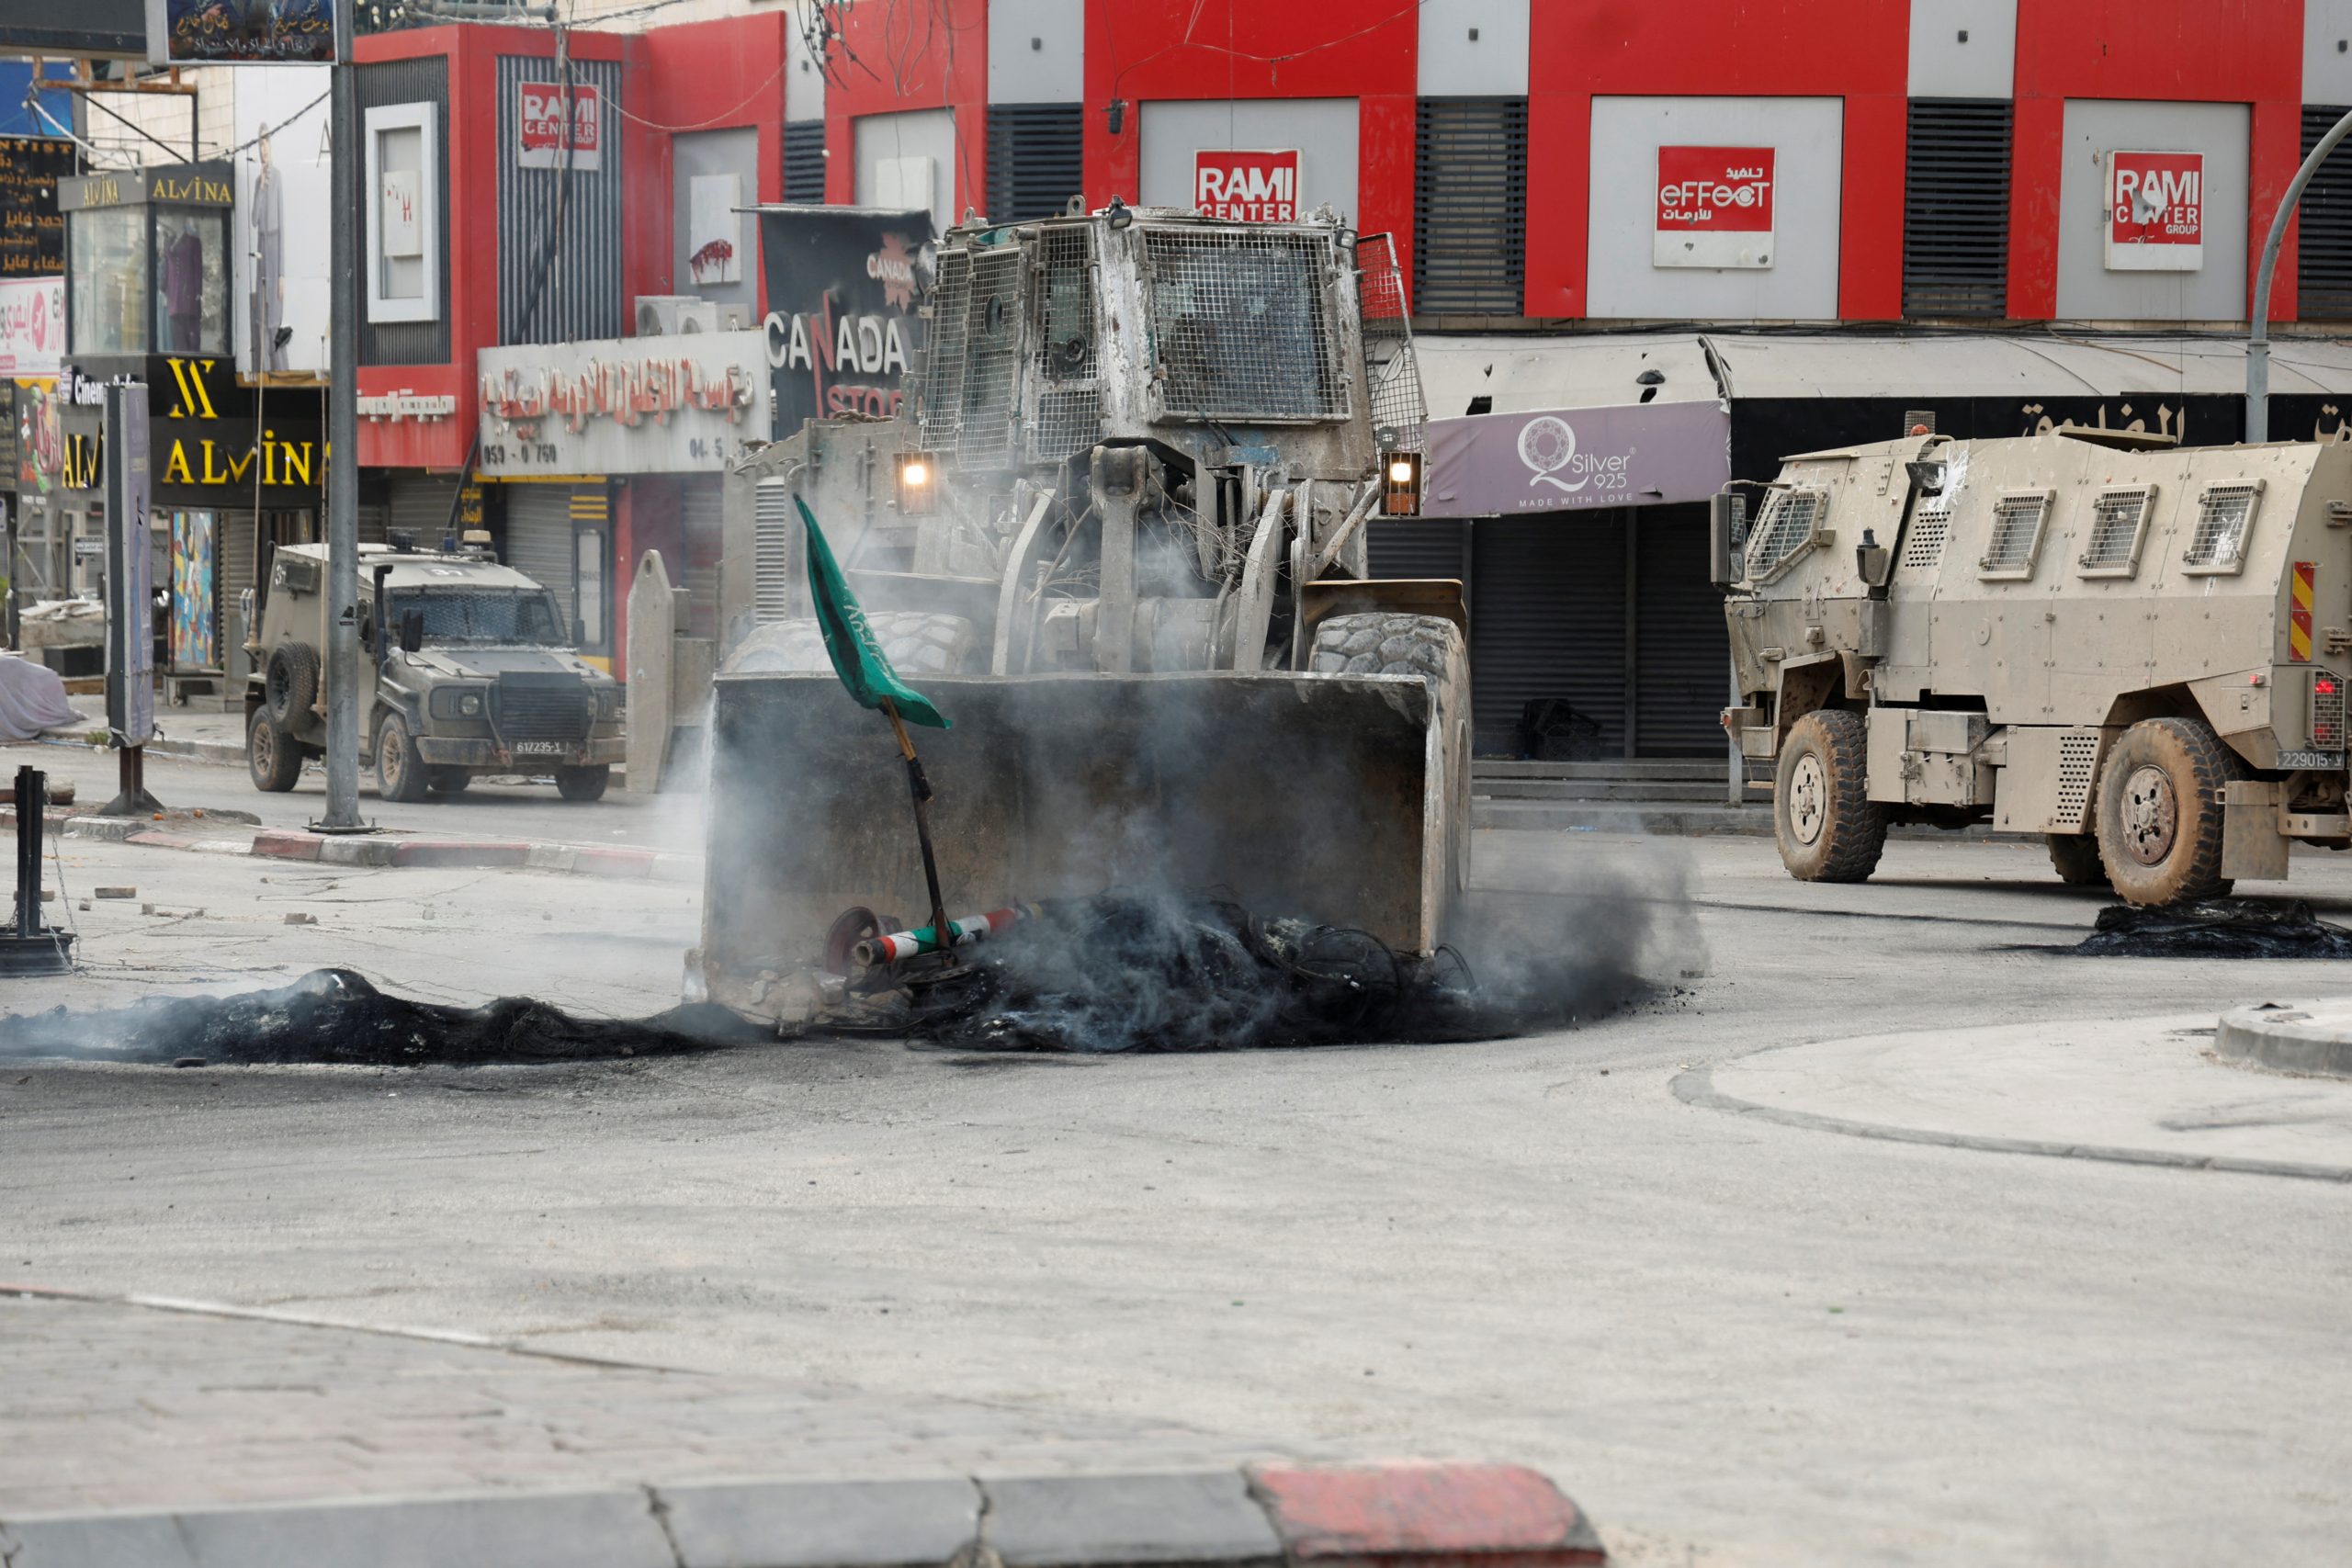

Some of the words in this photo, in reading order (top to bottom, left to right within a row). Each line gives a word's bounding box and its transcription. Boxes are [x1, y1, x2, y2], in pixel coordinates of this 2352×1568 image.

[1199, 167, 1294, 201] RAMI
[2116, 169, 2199, 205] RAMI
[1200, 203, 1292, 220] CENTER
[2165, 224, 2199, 235] GROUP
[1594, 473, 1627, 490] 925
[1519, 498, 1554, 507] MADE
[1561, 495, 1593, 505] WITH
[1600, 492, 1634, 502] LOVE
